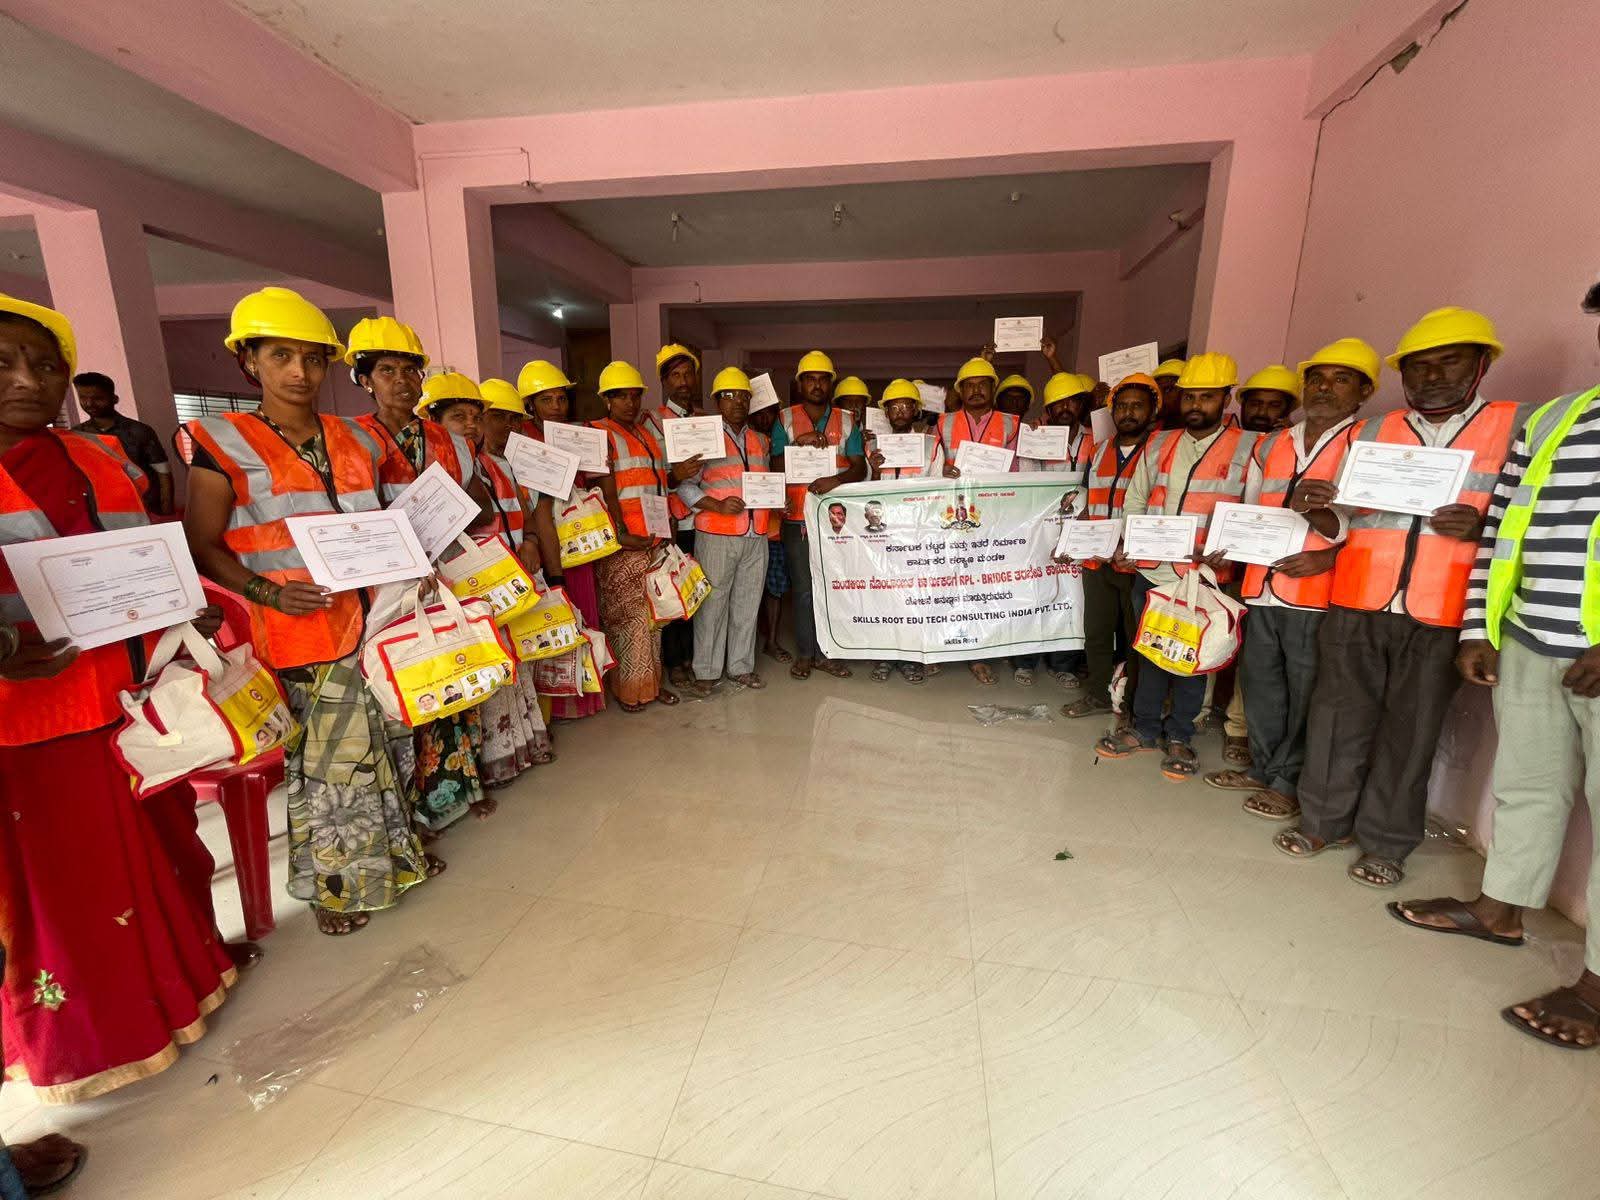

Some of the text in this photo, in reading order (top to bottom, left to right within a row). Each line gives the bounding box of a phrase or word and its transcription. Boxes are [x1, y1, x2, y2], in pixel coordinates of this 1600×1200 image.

[959, 575, 974, 585] RPL
[981, 571, 1012, 585] BRIDGE
[853, 602, 1073, 625] SKILLS ROOT EDU TECH CONSULTING INDIA PVT. LTD.
